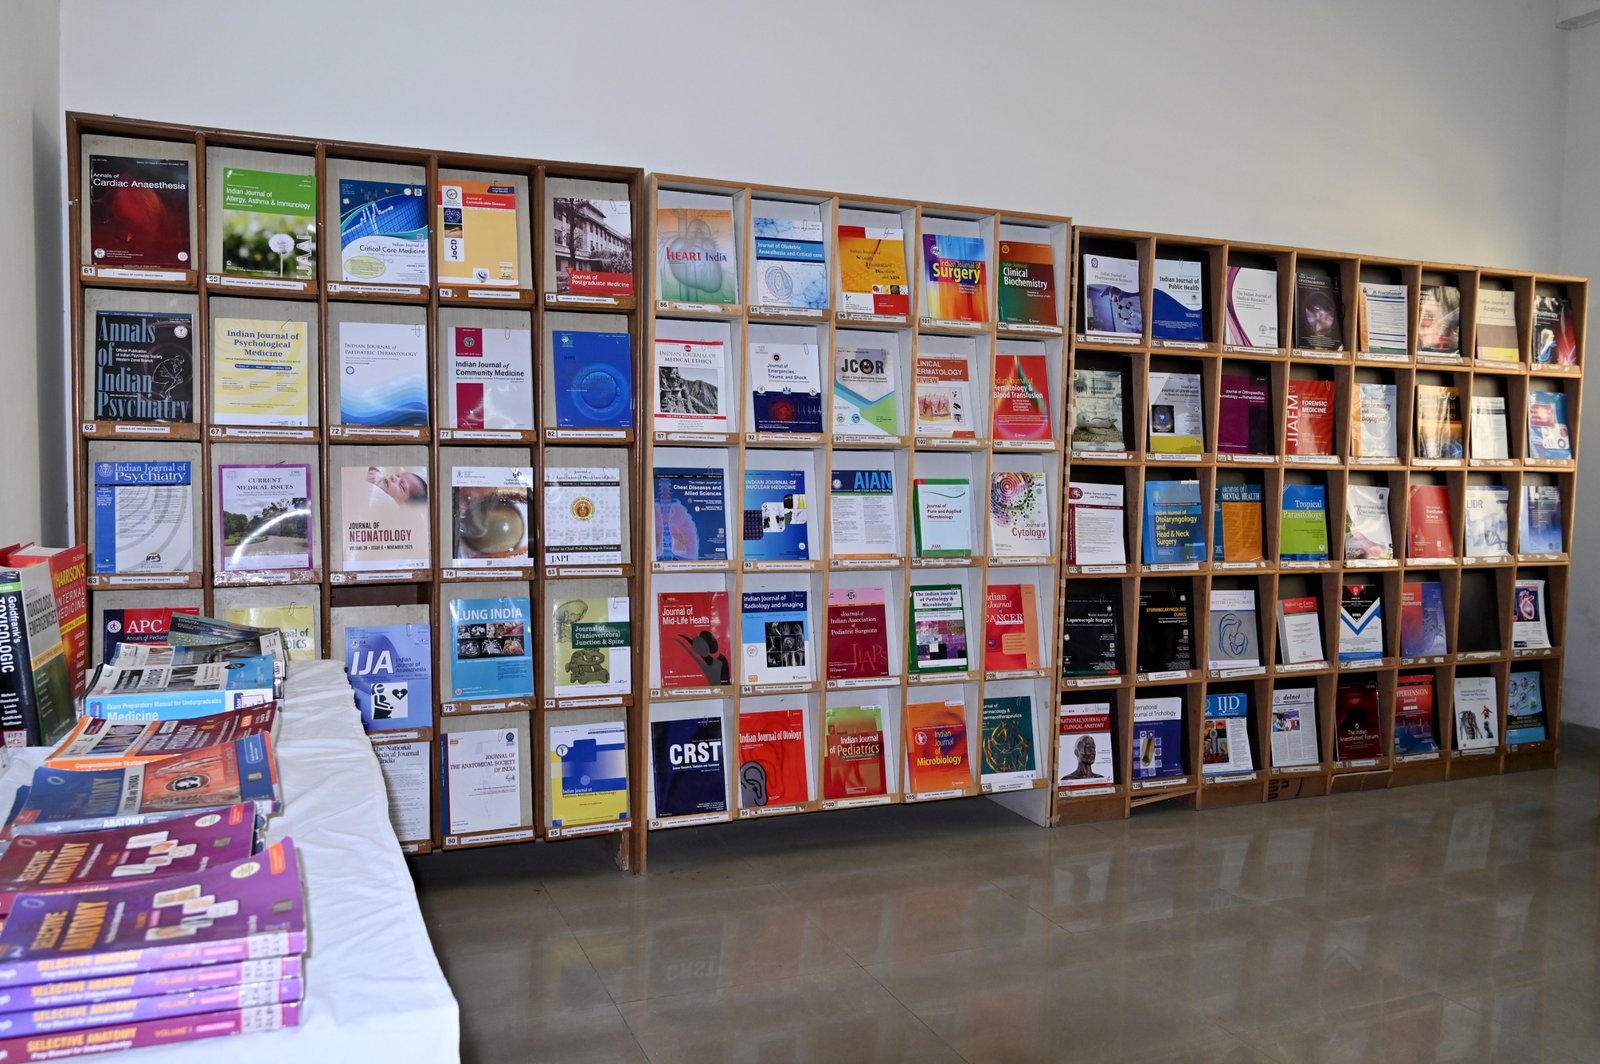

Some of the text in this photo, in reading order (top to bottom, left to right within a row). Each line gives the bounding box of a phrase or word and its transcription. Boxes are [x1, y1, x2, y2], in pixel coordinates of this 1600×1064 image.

[93, 179, 185, 190] Cardiac Anaesthesia
[244, 189, 264, 197] Journal
[360, 244, 380, 253] Critical
[398, 247, 425, 255] Medicine
[666, 247, 727, 262] HEART India
[933, 263, 981, 283] Surgery
[1003, 267, 1028, 277] Clinical
[1004, 277, 1047, 290] Biochemistry
[1176, 276, 1193, 286] Journal
[1184, 284, 1200, 292] Health
[98, 317, 156, 342] Annals
[227, 330, 254, 339] Indian
[257, 331, 286, 341] Journal
[234, 339, 291, 350] Psychological
[98, 342, 115, 367] of
[244, 349, 283, 357] Medicine
[477, 361, 501, 369] Journal
[455, 369, 492, 377] Community
[98, 368, 152, 394] Indian
[98, 391, 190, 419] Psychiatry
[1288, 395, 1299, 447] JIAFM
[115, 464, 142, 472] Indian
[144, 464, 175, 473] Journal
[115, 471, 186, 482] Psychiatry
[854, 471, 892, 489] AIAN
[1295, 500, 1322, 510] Tropical
[1155, 516, 1197, 524] Otolaryngology
[1283, 510, 1323, 520] Parasitology
[349, 522, 370, 530] JOURNAL
[349, 529, 412, 542] NEONATOLOGY
[1012, 527, 1046, 538] Cytology
[1157, 538, 1177, 546] Surgery
[550, 555, 569, 564] JAPI
[54, 563, 85, 588] HARRISON'S
[744, 602, 770, 610] Radiology
[781, 601, 803, 609] Imaging
[456, 607, 523, 620] LUNG INDIA
[662, 608, 684, 616] Journal
[7, 596, 21, 644] Goldfrank's
[126, 619, 163, 631] APC
[662, 617, 689, 625] Mid-Life
[350, 651, 394, 675] IJA
[1283, 693, 1301, 701] delnet
[1217, 696, 1239, 712] IJD
[107, 710, 158, 721] Medicine
[840, 734, 878, 744] Indian Journal
[934, 730, 952, 738] Indian
[935, 738, 954, 746] Journal
[670, 741, 721, 765] CRST
[830, 743, 880, 756] of Pediatrics
[917, 755, 961, 768] Microbiology
[103, 816, 145, 829] ANATOMY
[27, 1028, 137, 1052] SELECTIVE ANATOMY
